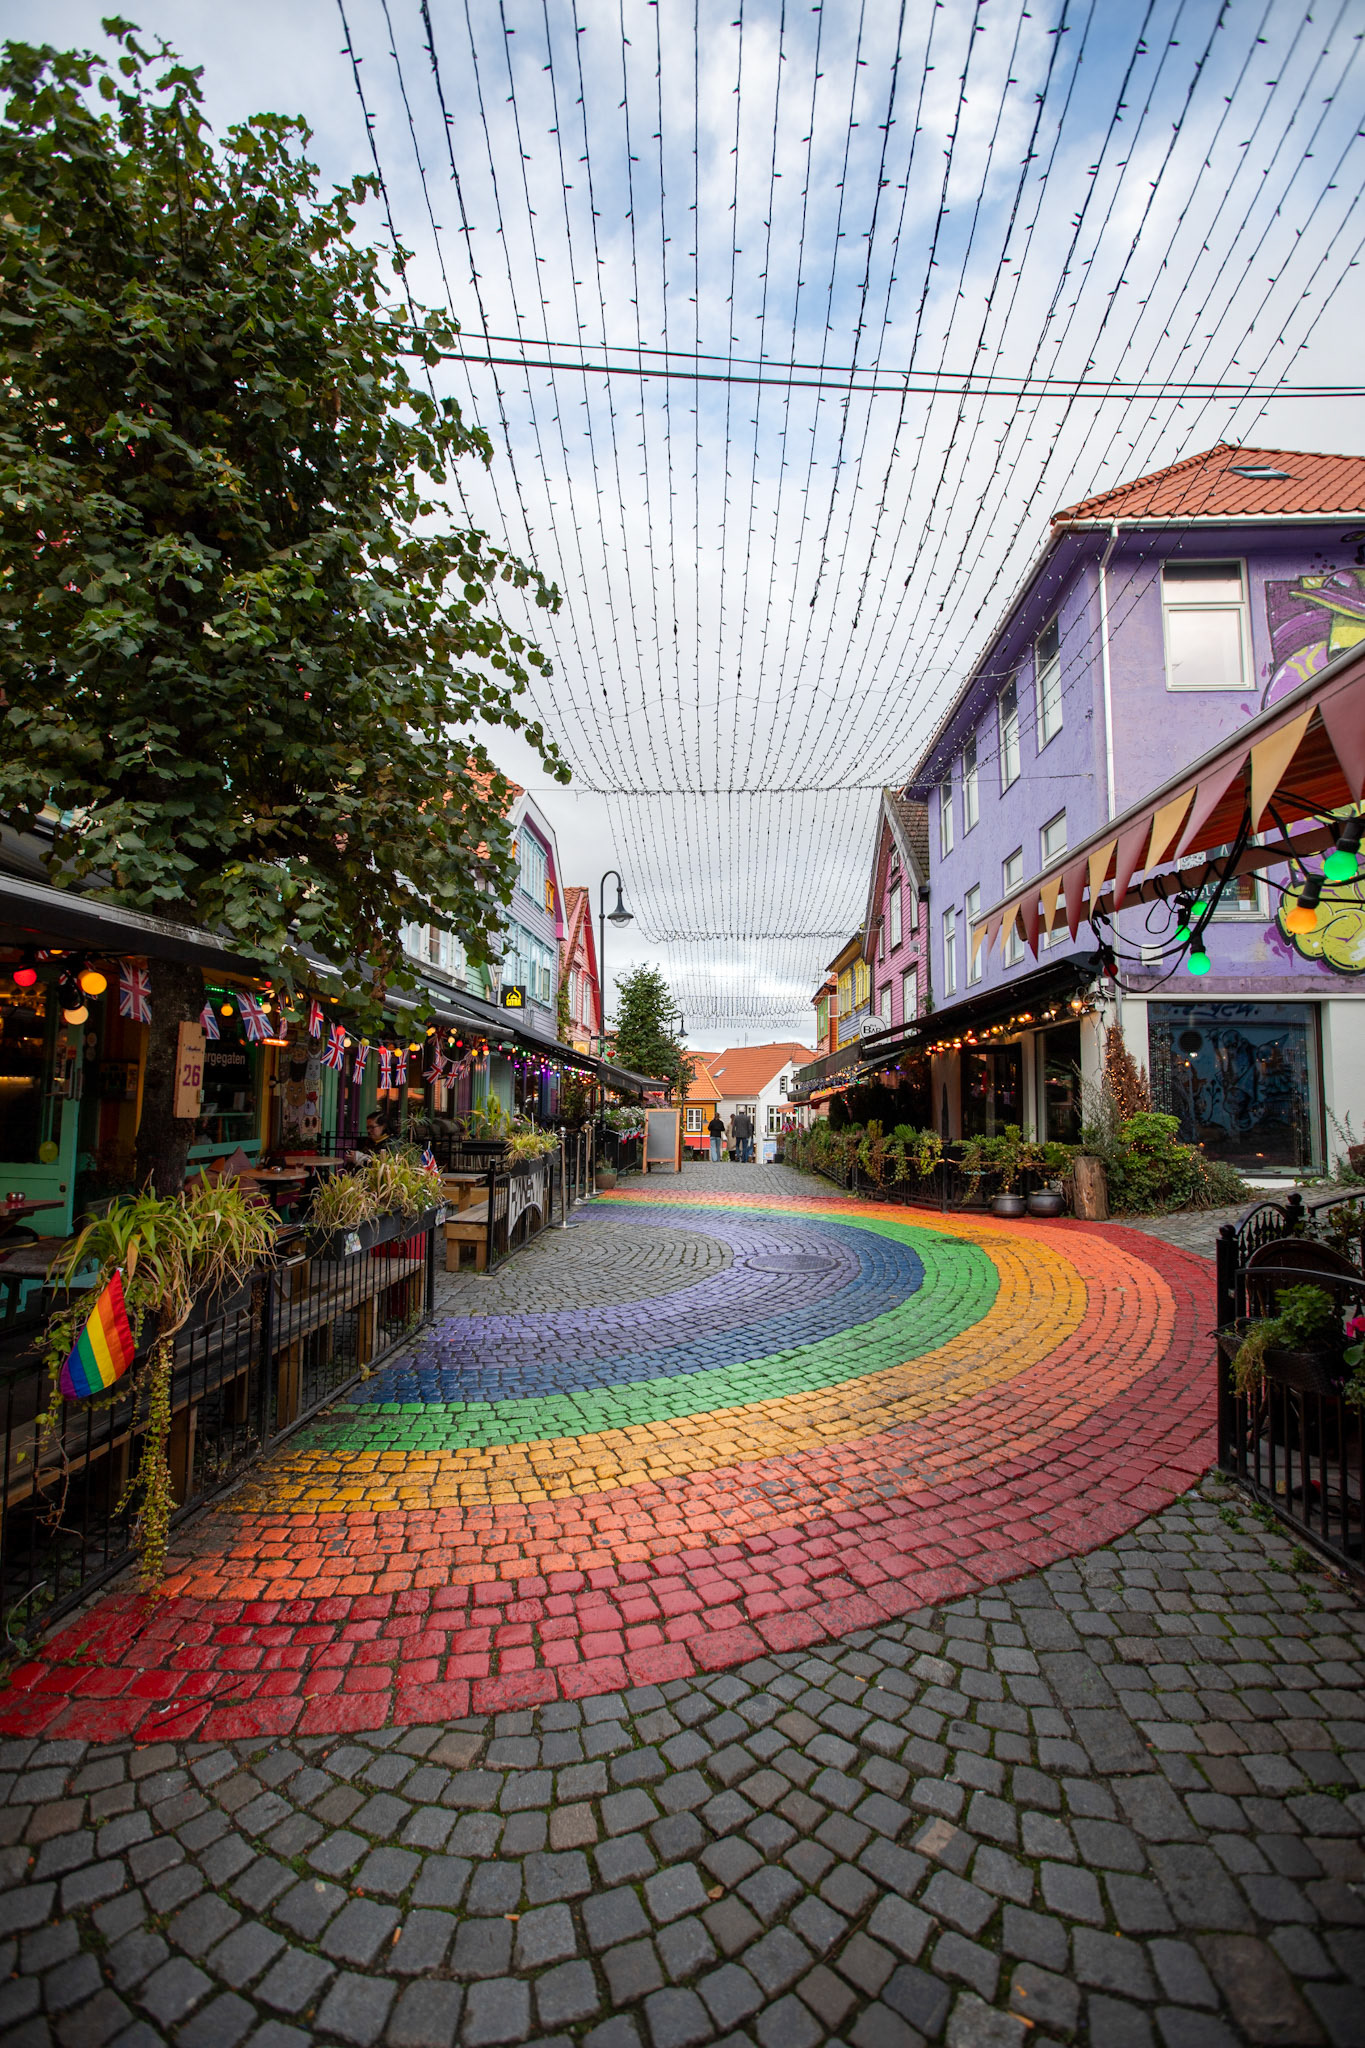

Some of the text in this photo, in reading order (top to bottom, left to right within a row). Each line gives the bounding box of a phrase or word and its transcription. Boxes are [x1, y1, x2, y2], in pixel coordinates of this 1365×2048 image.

[863, 1025, 881, 1034] BAR
[204, 1052, 246, 1066] argegaten
[182, 1064, 201, 1087] 26
